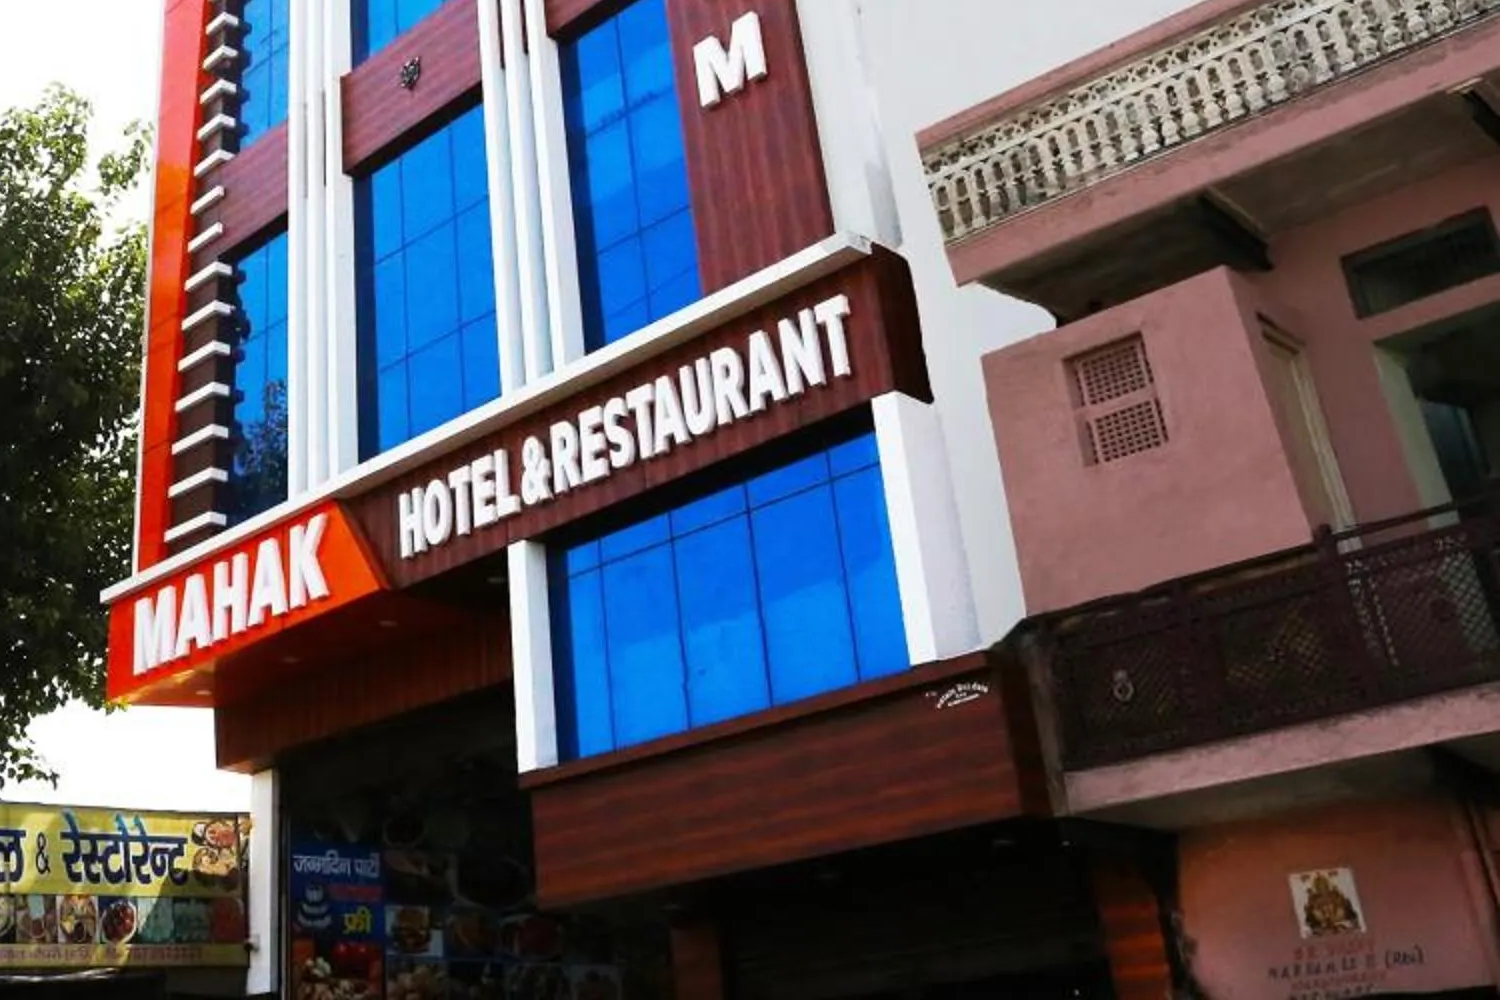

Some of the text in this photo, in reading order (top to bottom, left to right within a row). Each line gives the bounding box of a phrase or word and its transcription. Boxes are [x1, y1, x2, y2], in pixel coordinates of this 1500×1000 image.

[398, 447, 521, 560] HOTEL
[132, 512, 331, 677] MAHAK
[36, 833, 52, 876] &
[341, 905, 373, 936] फ्री
